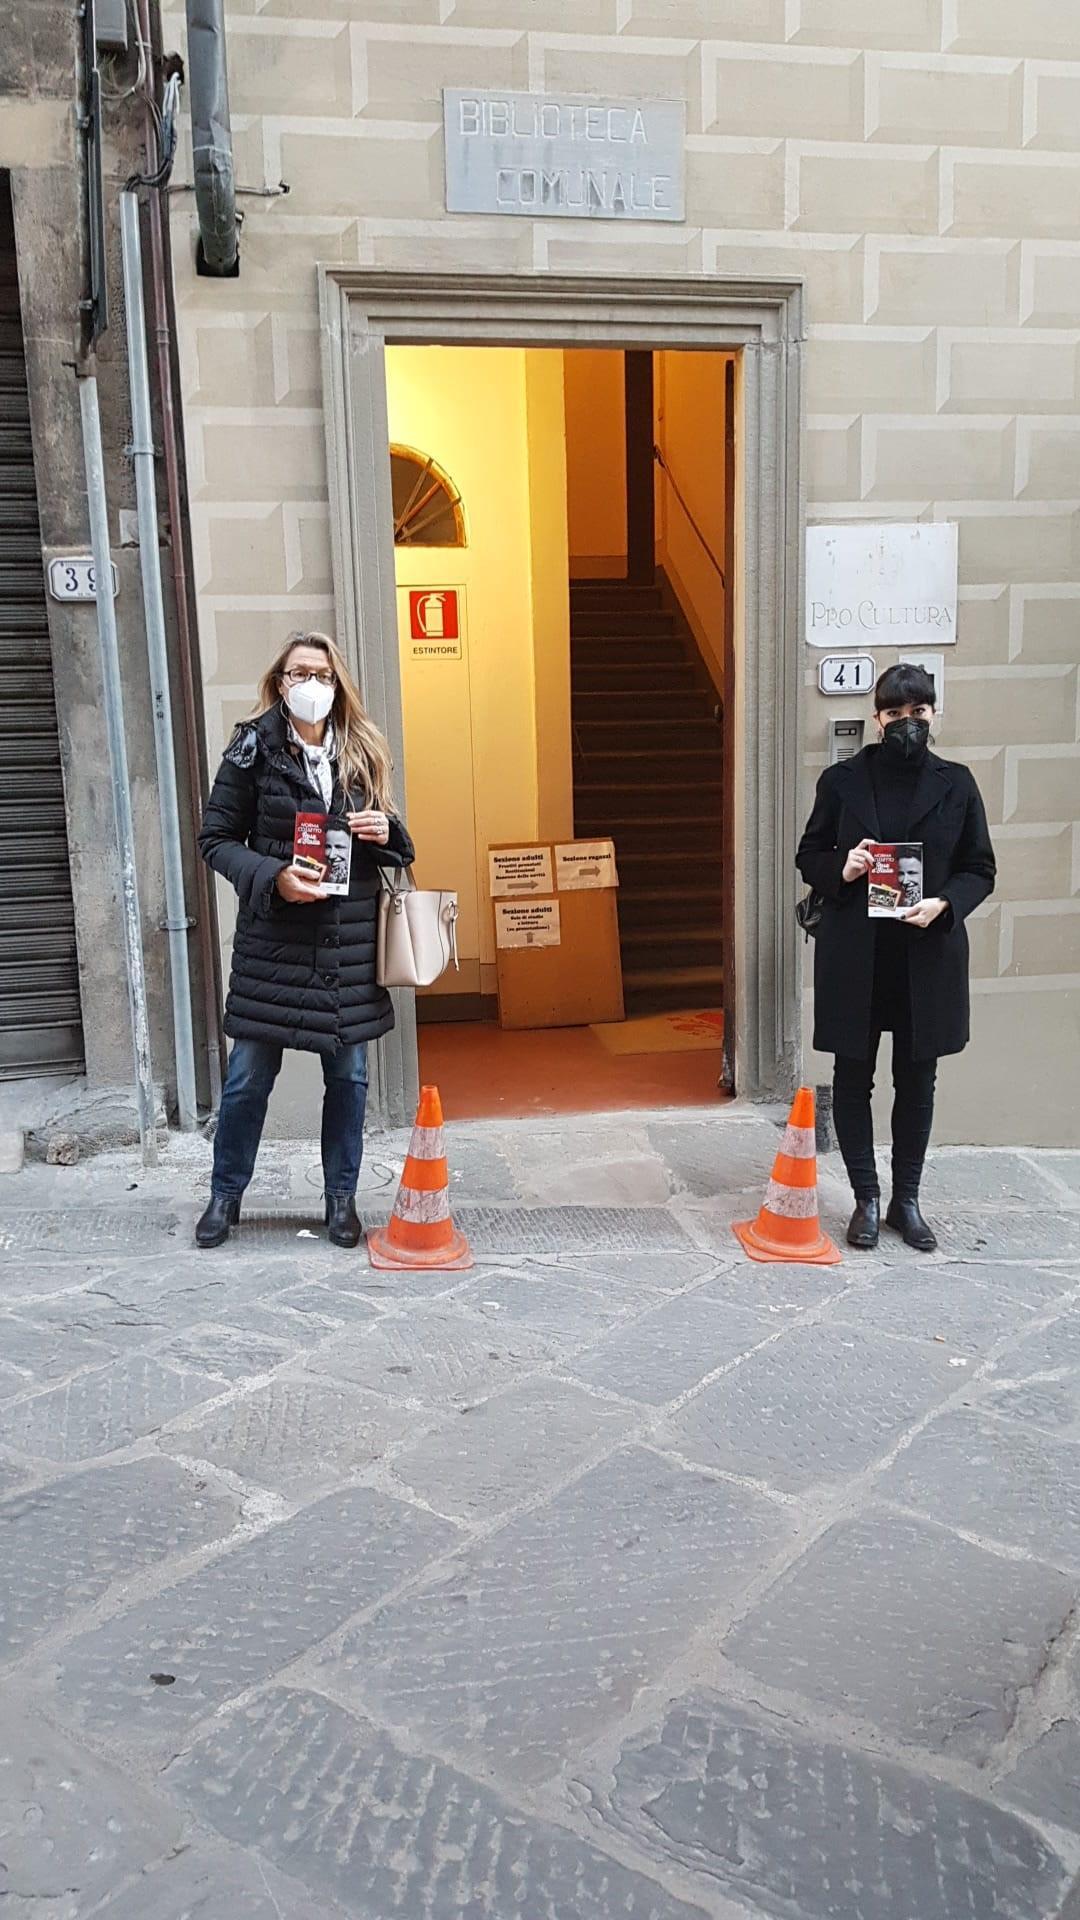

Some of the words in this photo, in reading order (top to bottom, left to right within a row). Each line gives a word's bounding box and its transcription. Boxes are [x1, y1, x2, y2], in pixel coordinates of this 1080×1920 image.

[459, 98, 649, 144] BIBLIOTECA
[496, 167, 672, 211] COMUNALE
[65, 567, 97, 592] 39
[811, 601, 853, 629] PRO
[858, 600, 953, 630] CULTURA
[413, 646, 458, 655] ESTINTORE
[833, 663, 861, 686] 41
[588, 853, 612, 861] ragazzi
